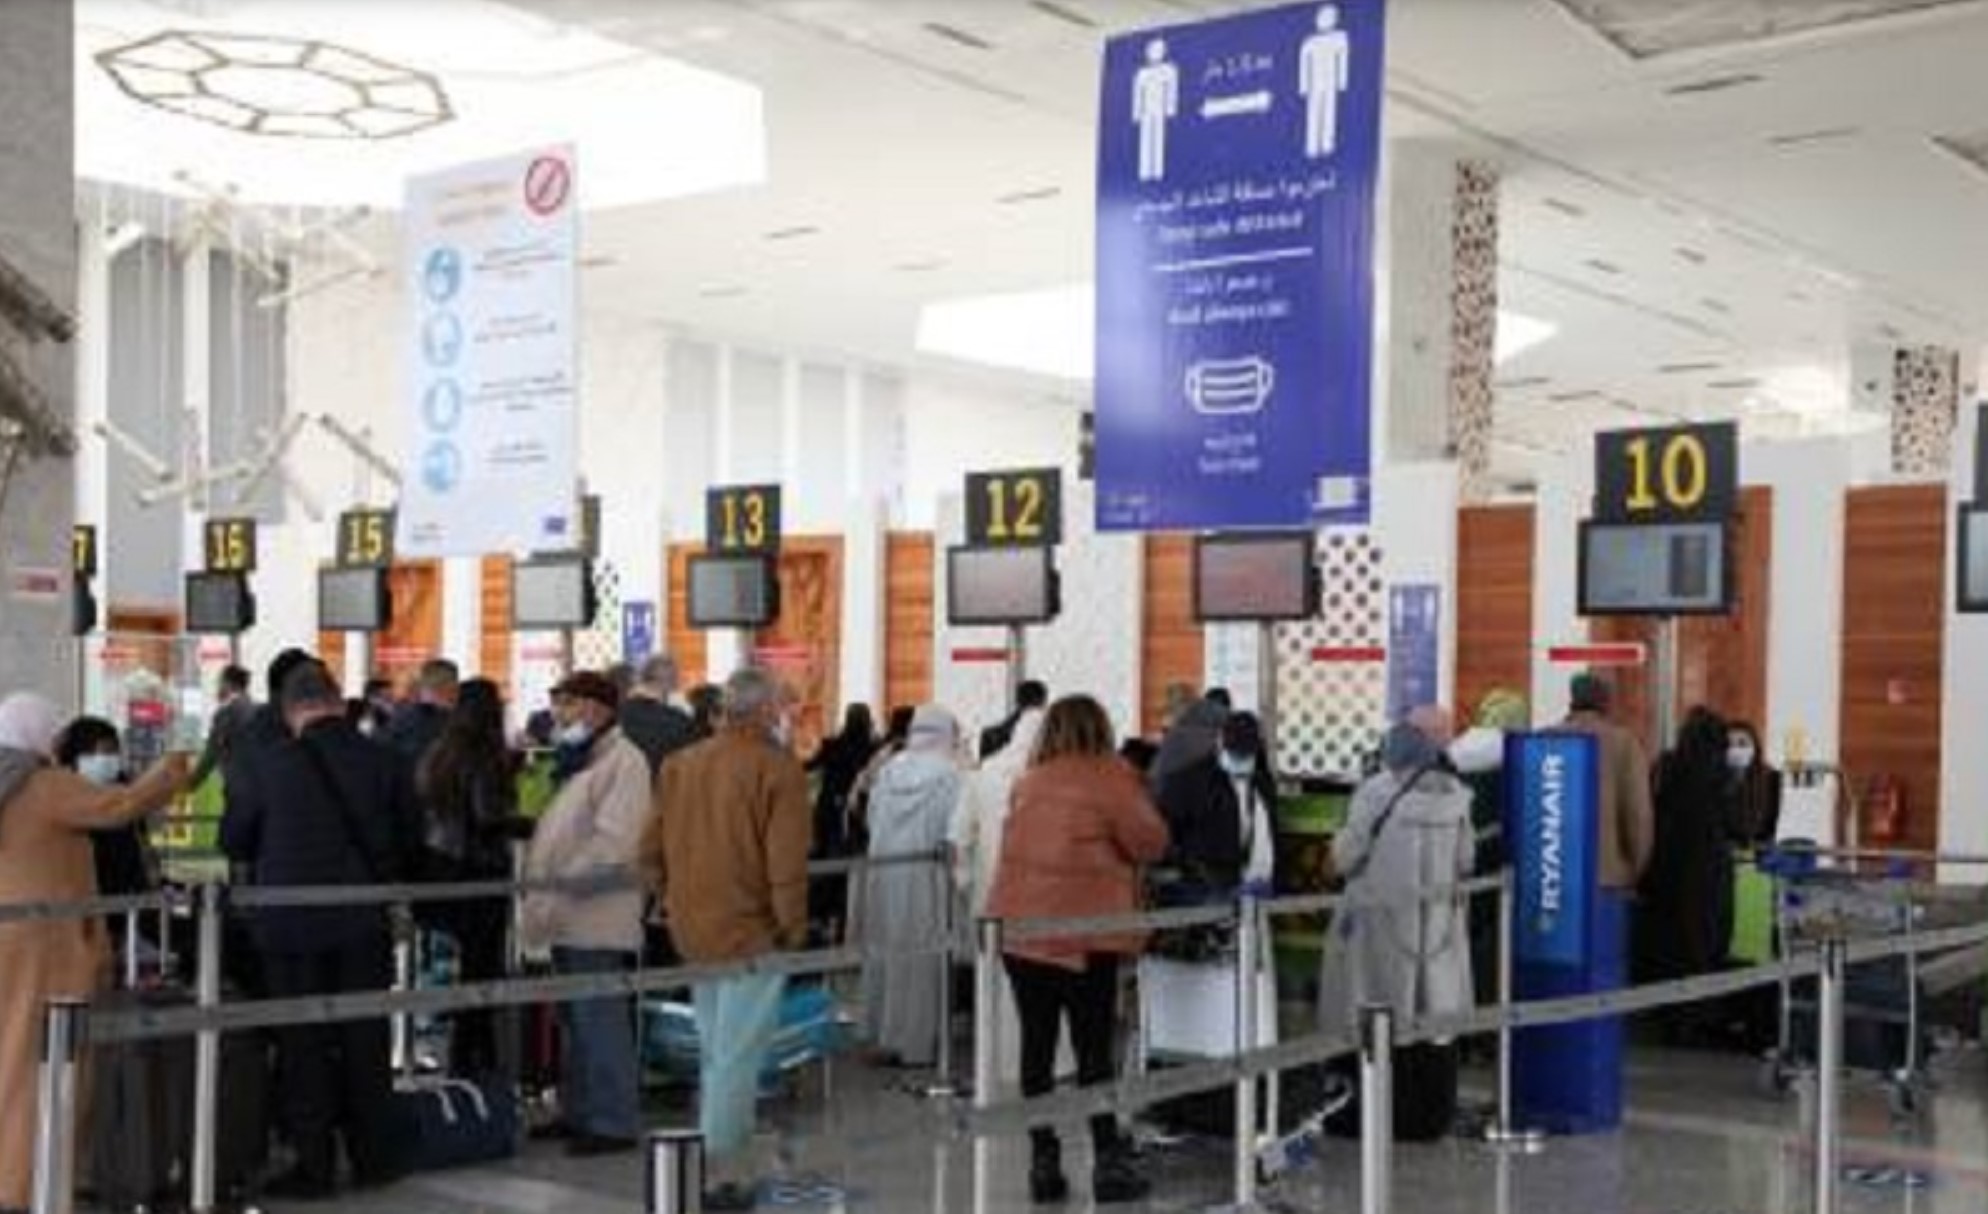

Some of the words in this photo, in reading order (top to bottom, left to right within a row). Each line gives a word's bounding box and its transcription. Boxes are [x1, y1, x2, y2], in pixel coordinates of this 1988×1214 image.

[1625, 433, 1707, 510] 10
[722, 492, 765, 548] 13
[985, 477, 1042, 538] 12
[346, 516, 384, 563] 15
[1540, 753, 1565, 910] RYANAIR
